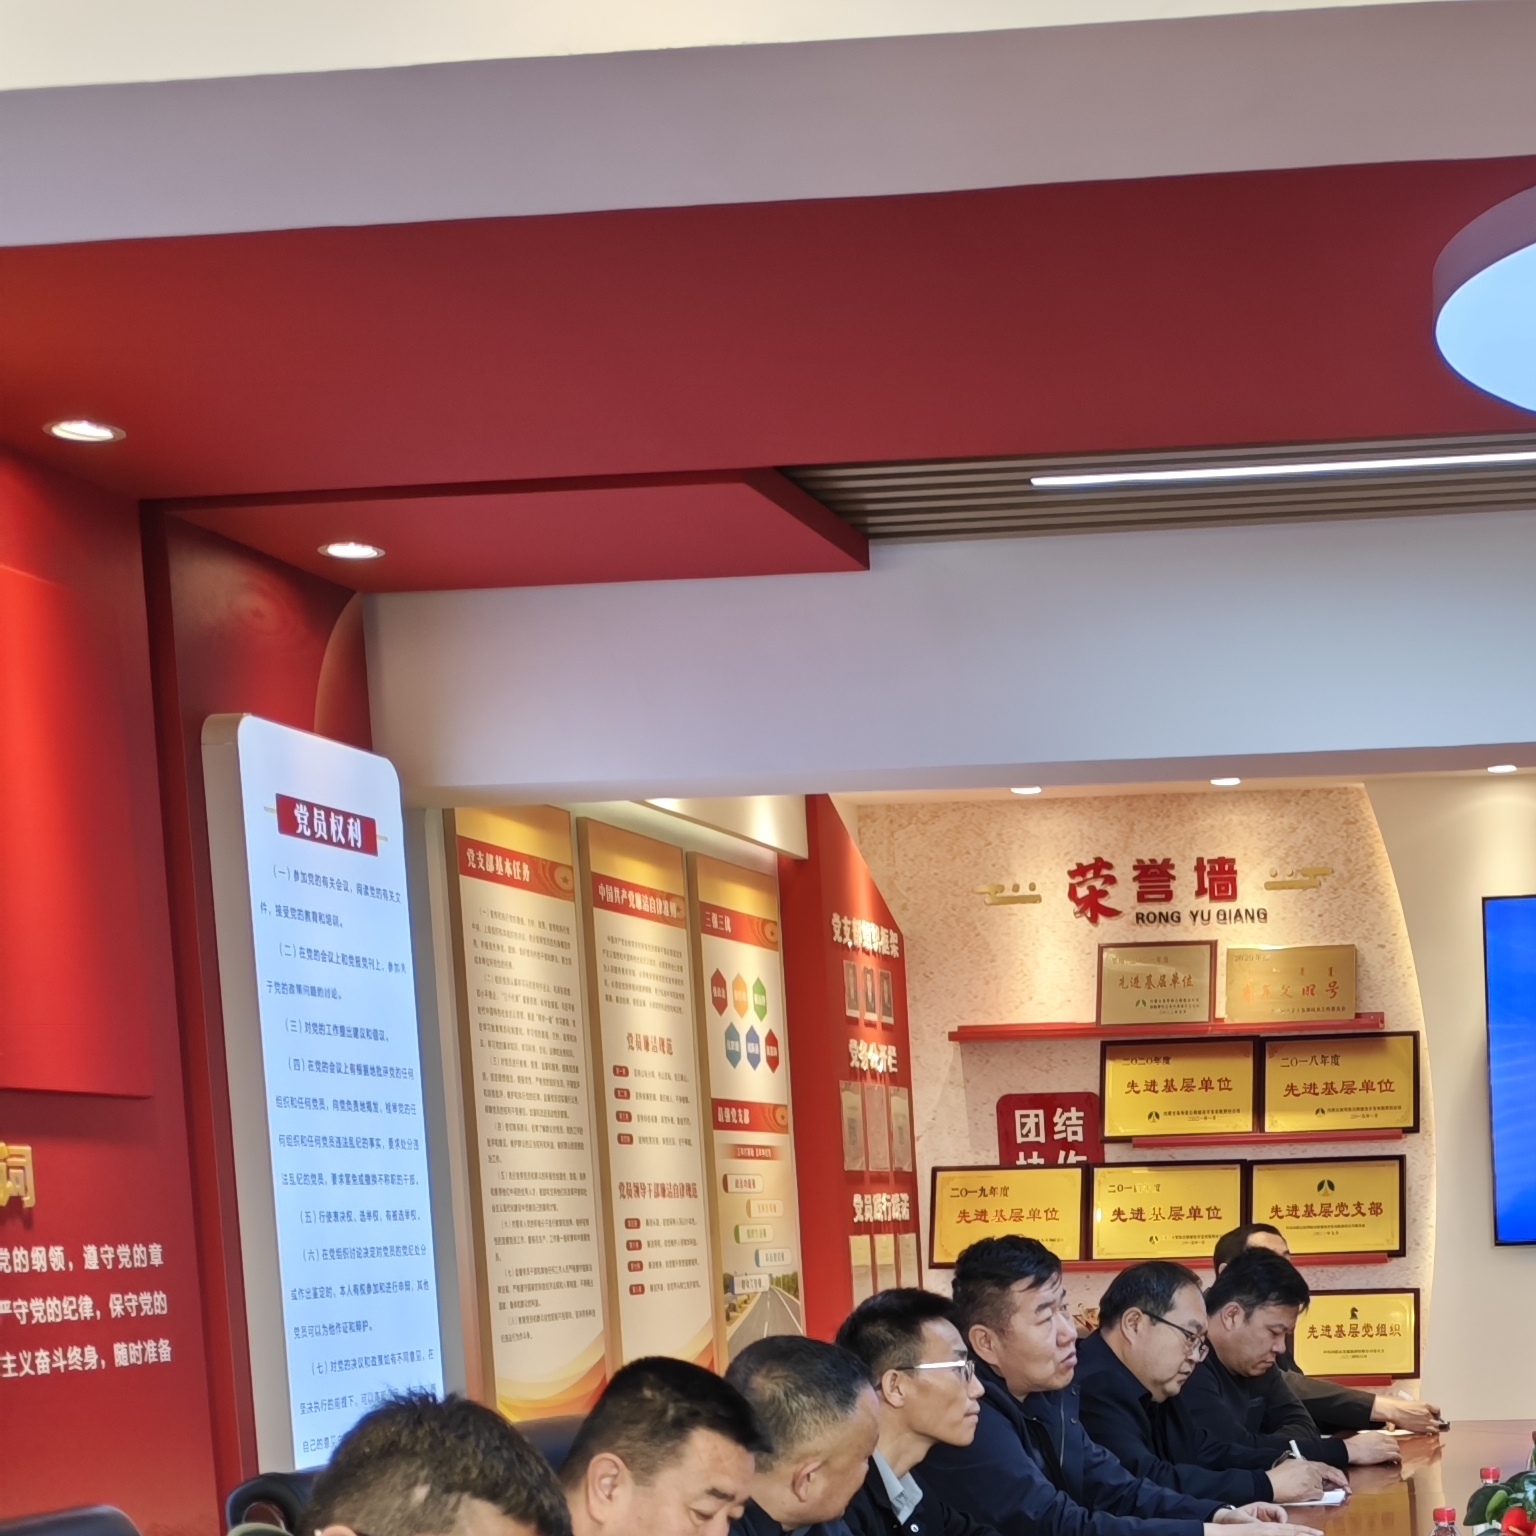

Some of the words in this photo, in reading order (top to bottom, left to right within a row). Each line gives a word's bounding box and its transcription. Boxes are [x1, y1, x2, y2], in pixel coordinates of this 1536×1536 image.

[294, 803, 362, 849] 党员权利
[467, 847, 530, 882] 党支部基本任务
[1068, 856, 1238, 926] 荣誉墙
[1135, 911, 1181, 924] RONG
[1190, 910, 1211, 925] YU
[1216, 908, 1268, 924] QIANG
[1124, 1076, 1233, 1095] 先进基层单位
[1283, 1078, 1395, 1098] 先进基层单位
[1015, 1107, 1084, 1144] 团结
[956, 1207, 1060, 1224] 先进基层单位
[1110, 1205, 1223, 1223] 先进基层单位
[1269, 1201, 1383, 1219] 先进基层党支部
[1307, 1323, 1402, 1340] 先进基层党组织
[0, 1338, 172, 1378] 主义奋斗终身，随时准备
